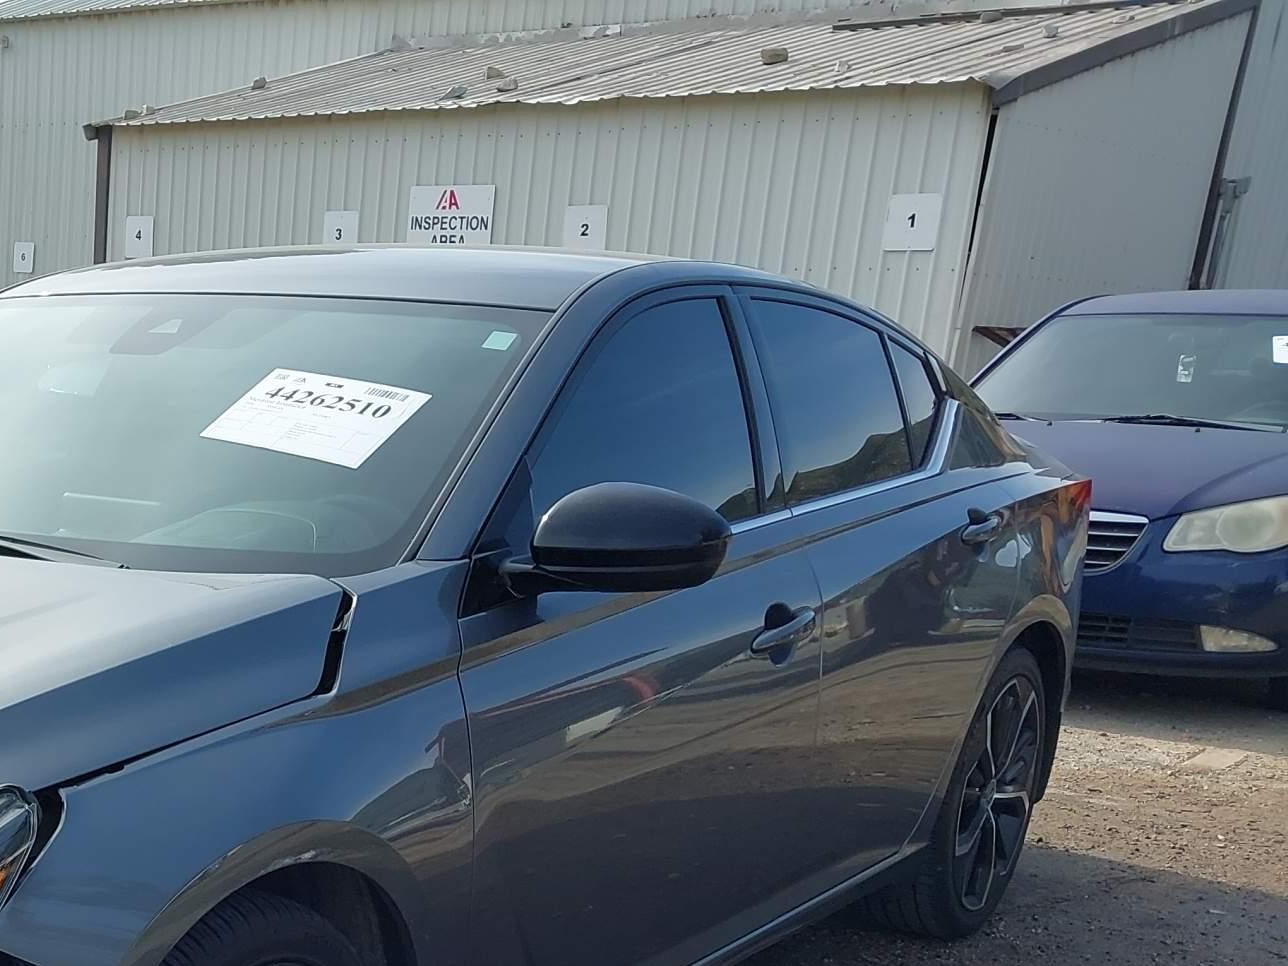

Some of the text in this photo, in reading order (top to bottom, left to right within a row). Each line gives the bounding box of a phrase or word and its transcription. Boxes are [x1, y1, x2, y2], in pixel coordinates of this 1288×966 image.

[410, 215, 489, 231] INSPECTION
[907, 213, 916, 229] 1
[135, 229, 142, 241] 4
[335, 228, 342, 241] 3
[580, 223, 590, 237] 2
[20, 252, 26, 262] 6
[264, 386, 392, 419] 44262510
